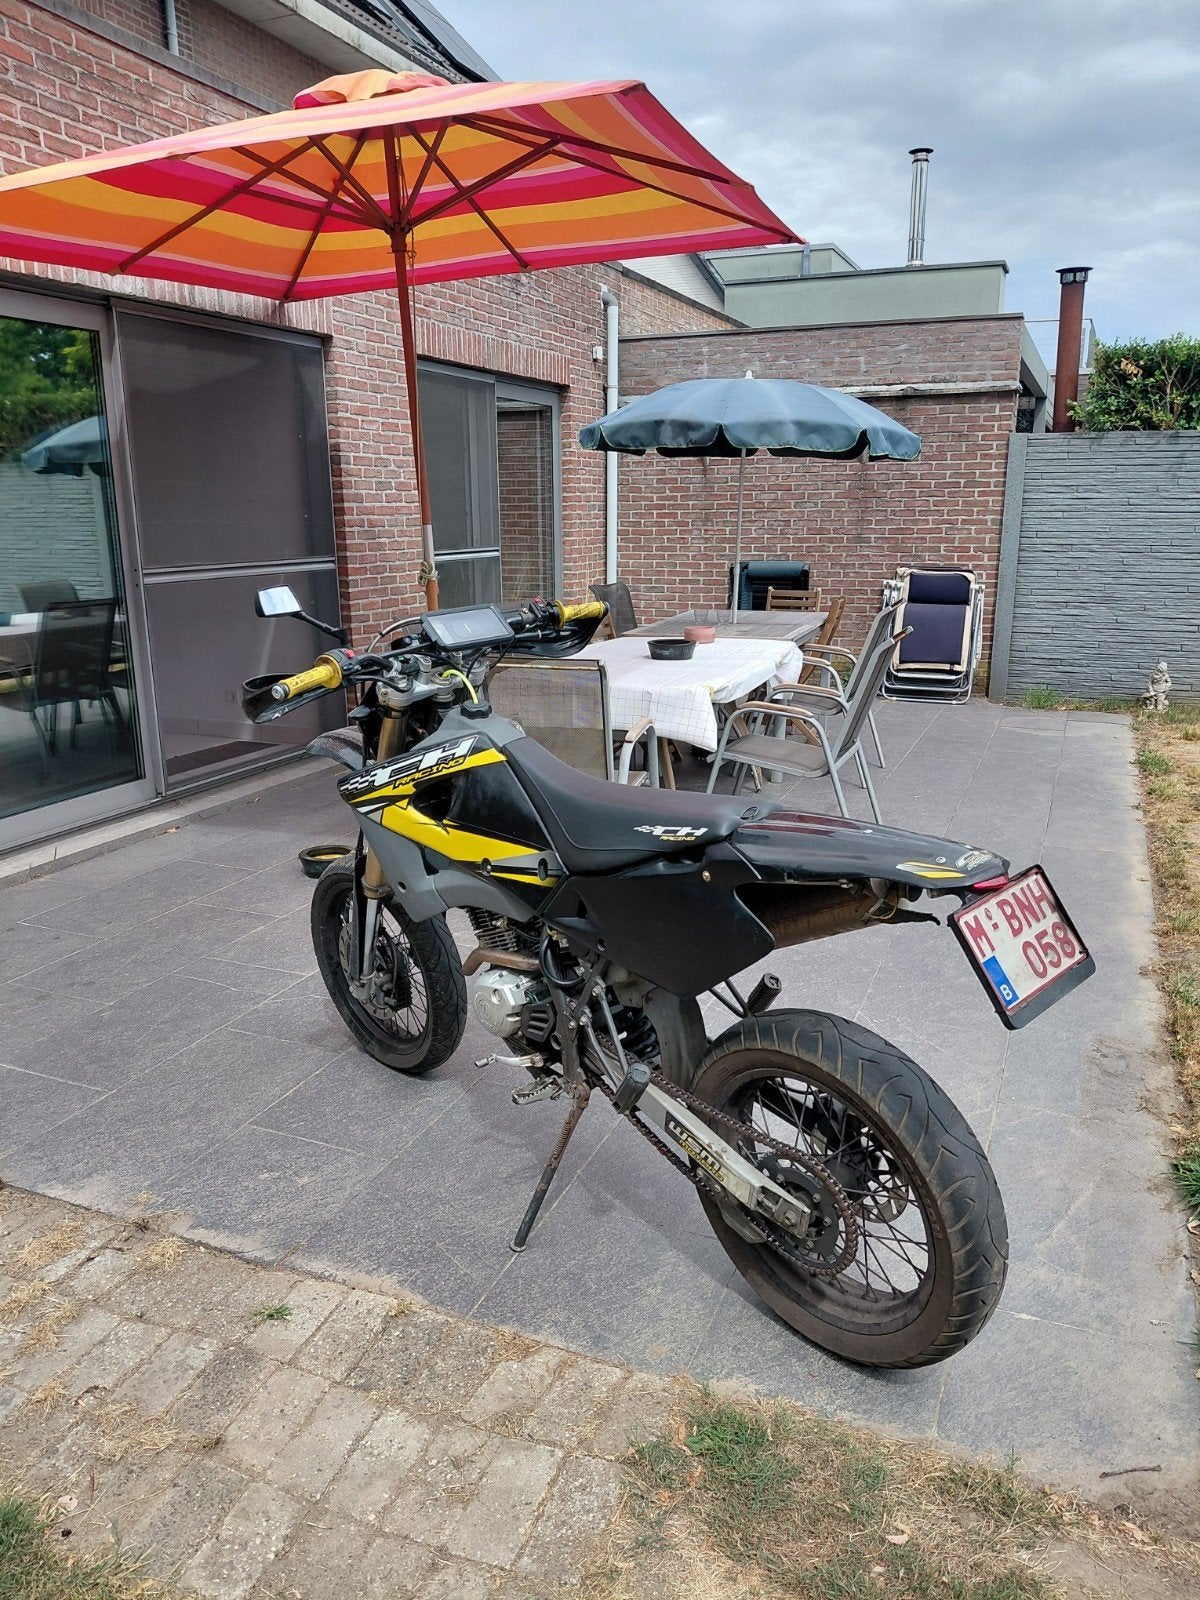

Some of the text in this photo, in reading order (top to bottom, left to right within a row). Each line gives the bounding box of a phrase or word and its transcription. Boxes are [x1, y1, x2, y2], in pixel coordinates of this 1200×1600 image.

[371, 737, 476, 786] CH
[394, 756, 464, 788] RACING
[1021, 921, 1077, 979] 058
[999, 983, 1013, 1001] B
